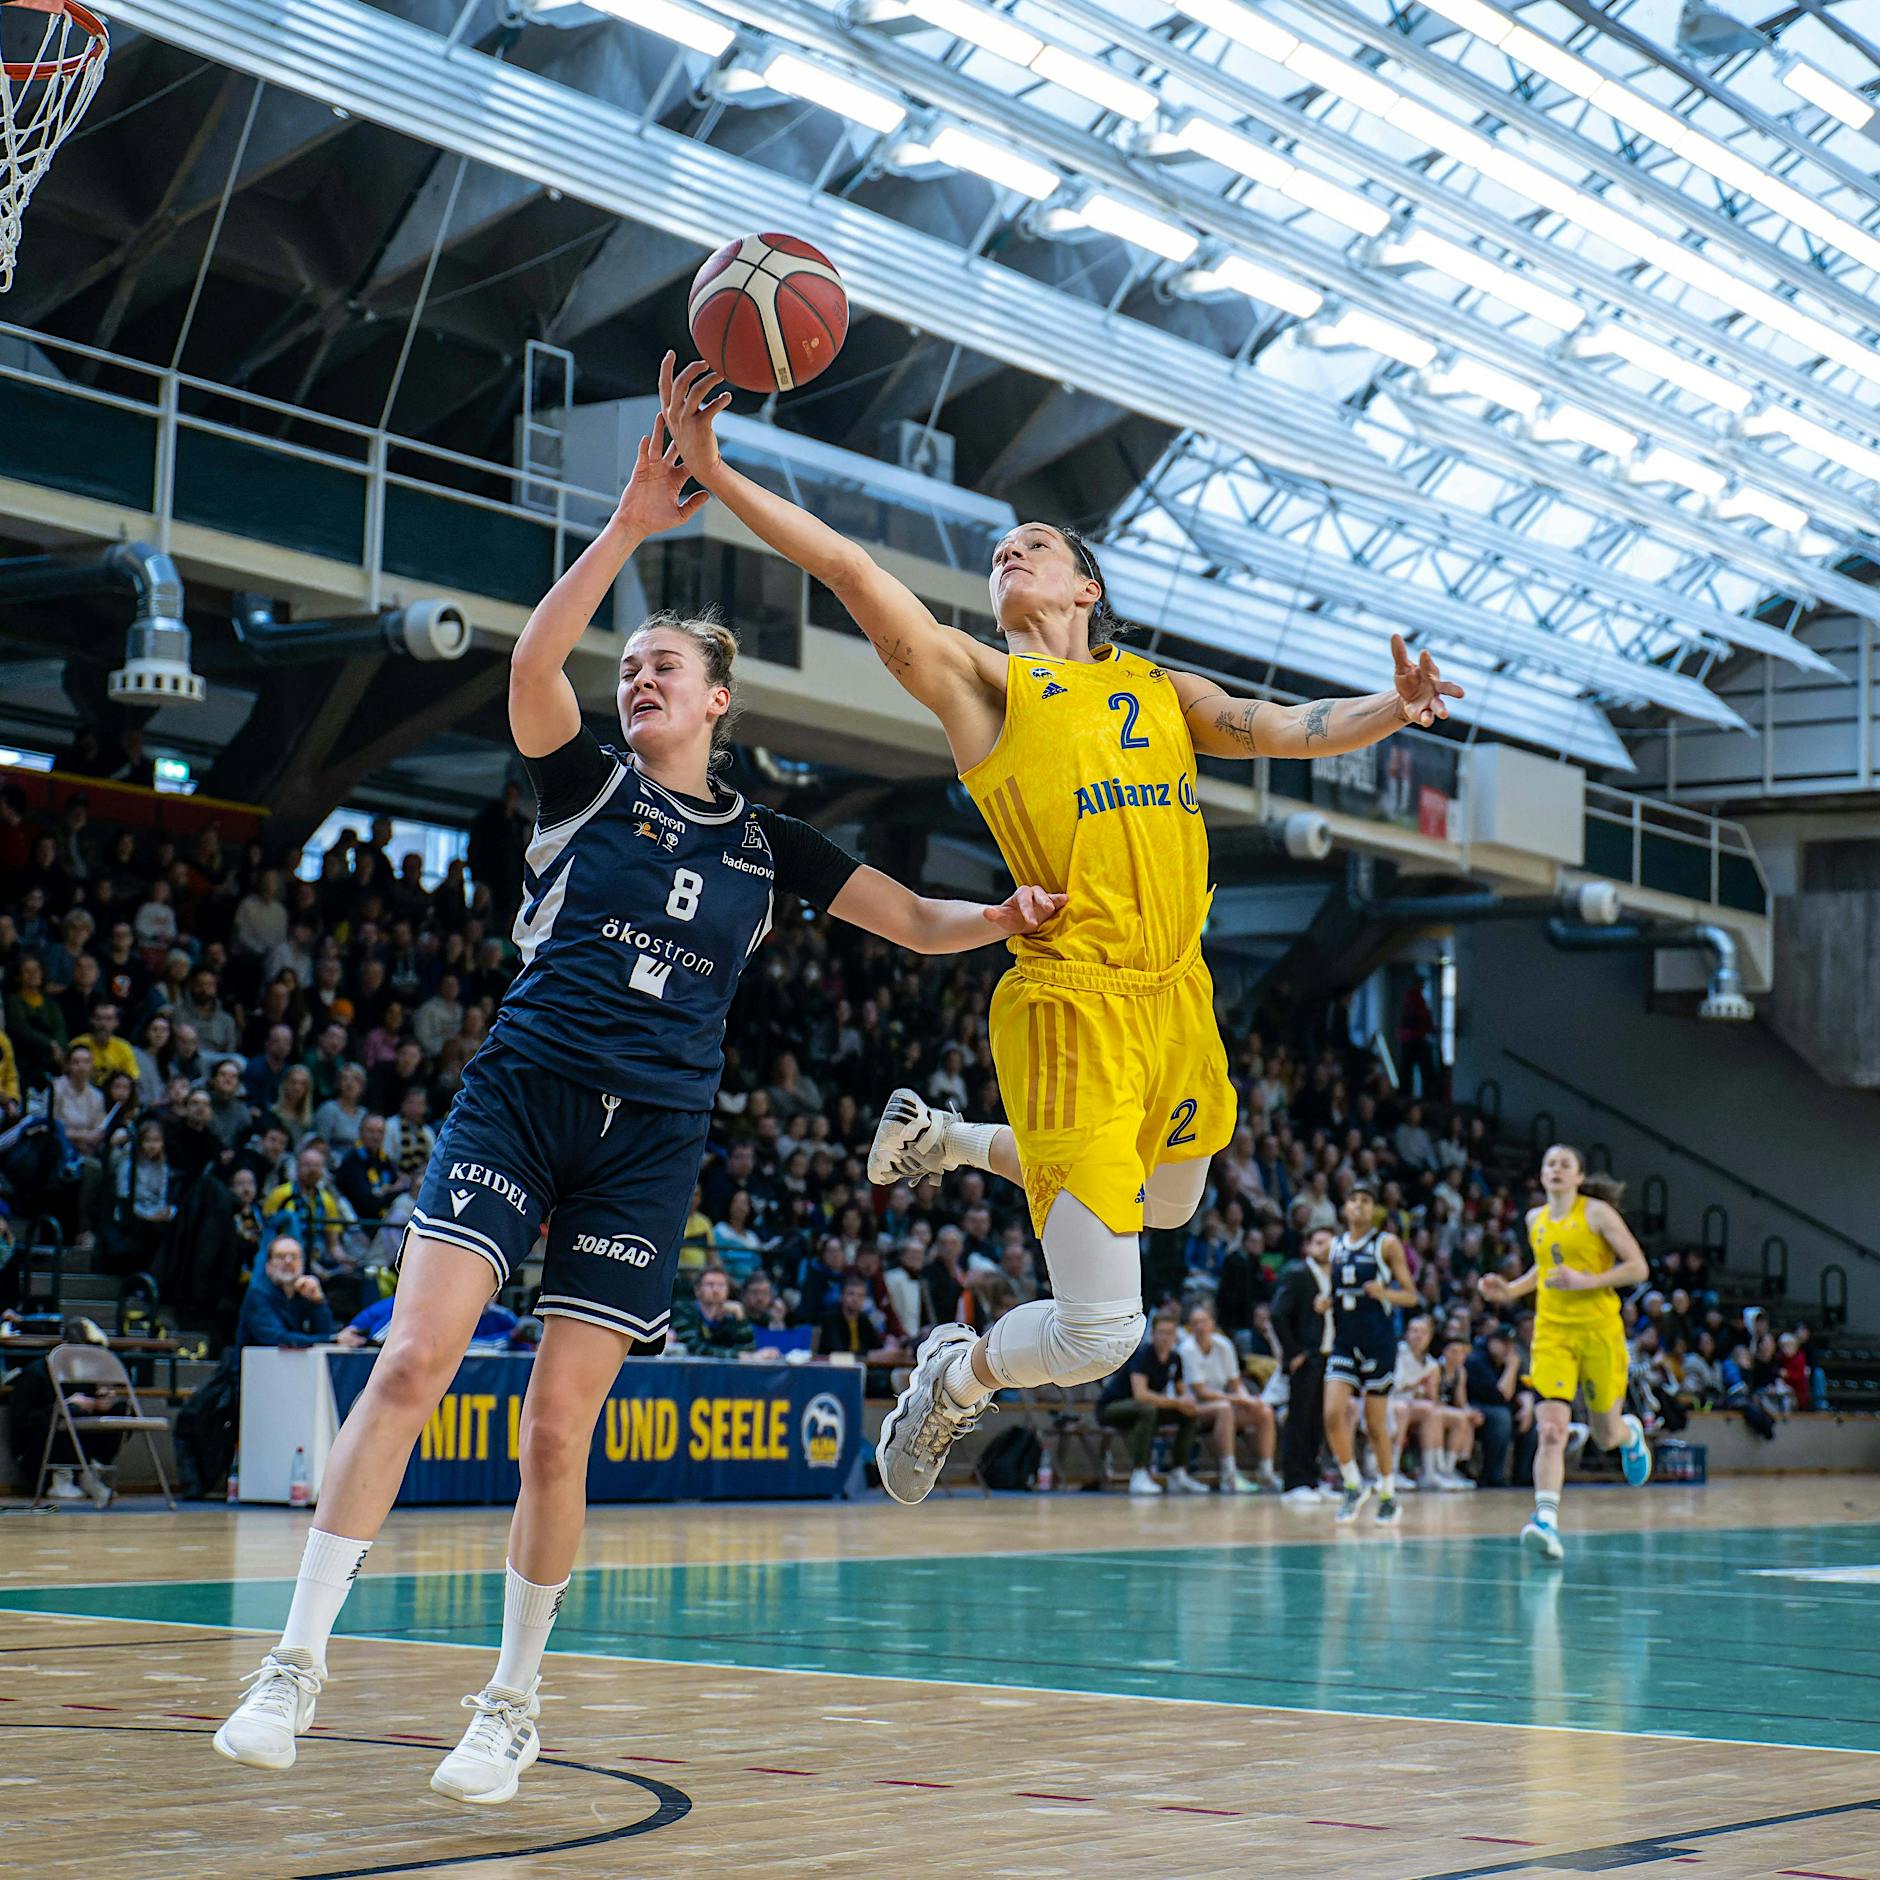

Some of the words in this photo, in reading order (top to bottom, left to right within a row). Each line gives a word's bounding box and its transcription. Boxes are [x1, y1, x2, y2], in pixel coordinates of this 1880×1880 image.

[1108, 692, 1149, 749] 2
[1074, 778, 1171, 819] Allianz
[666, 867, 704, 921] 8
[602, 918, 714, 976] ökostrom
[1167, 1098, 1197, 1147] 2
[448, 1163, 527, 1216] KEIDEL
[572, 1234, 651, 1268] JOBRAD
[420, 1393, 497, 1461] MIT
[605, 1398, 678, 1462] UND
[688, 1398, 791, 1461] SEELE
